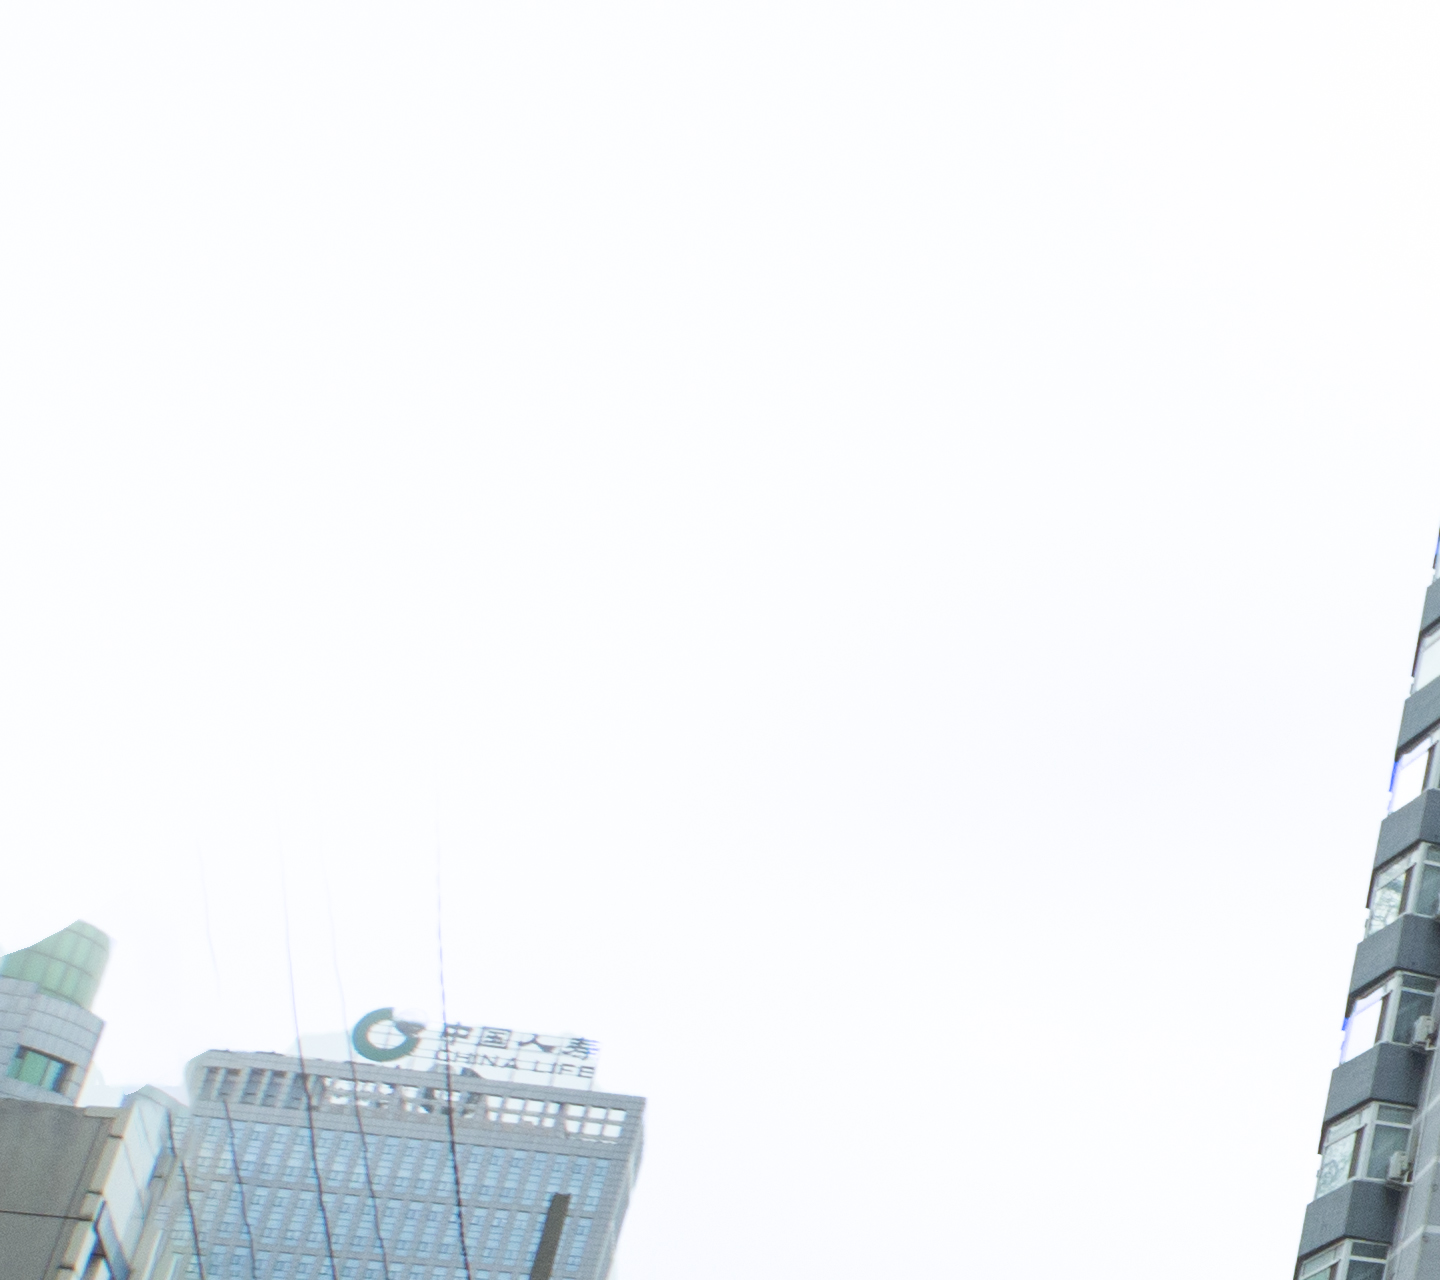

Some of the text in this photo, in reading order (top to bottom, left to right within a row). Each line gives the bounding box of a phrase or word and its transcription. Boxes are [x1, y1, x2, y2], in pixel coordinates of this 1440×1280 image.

[440, 1022, 600, 1060] 中国人寿
[436, 1048, 597, 1079] CHINA LIFE
